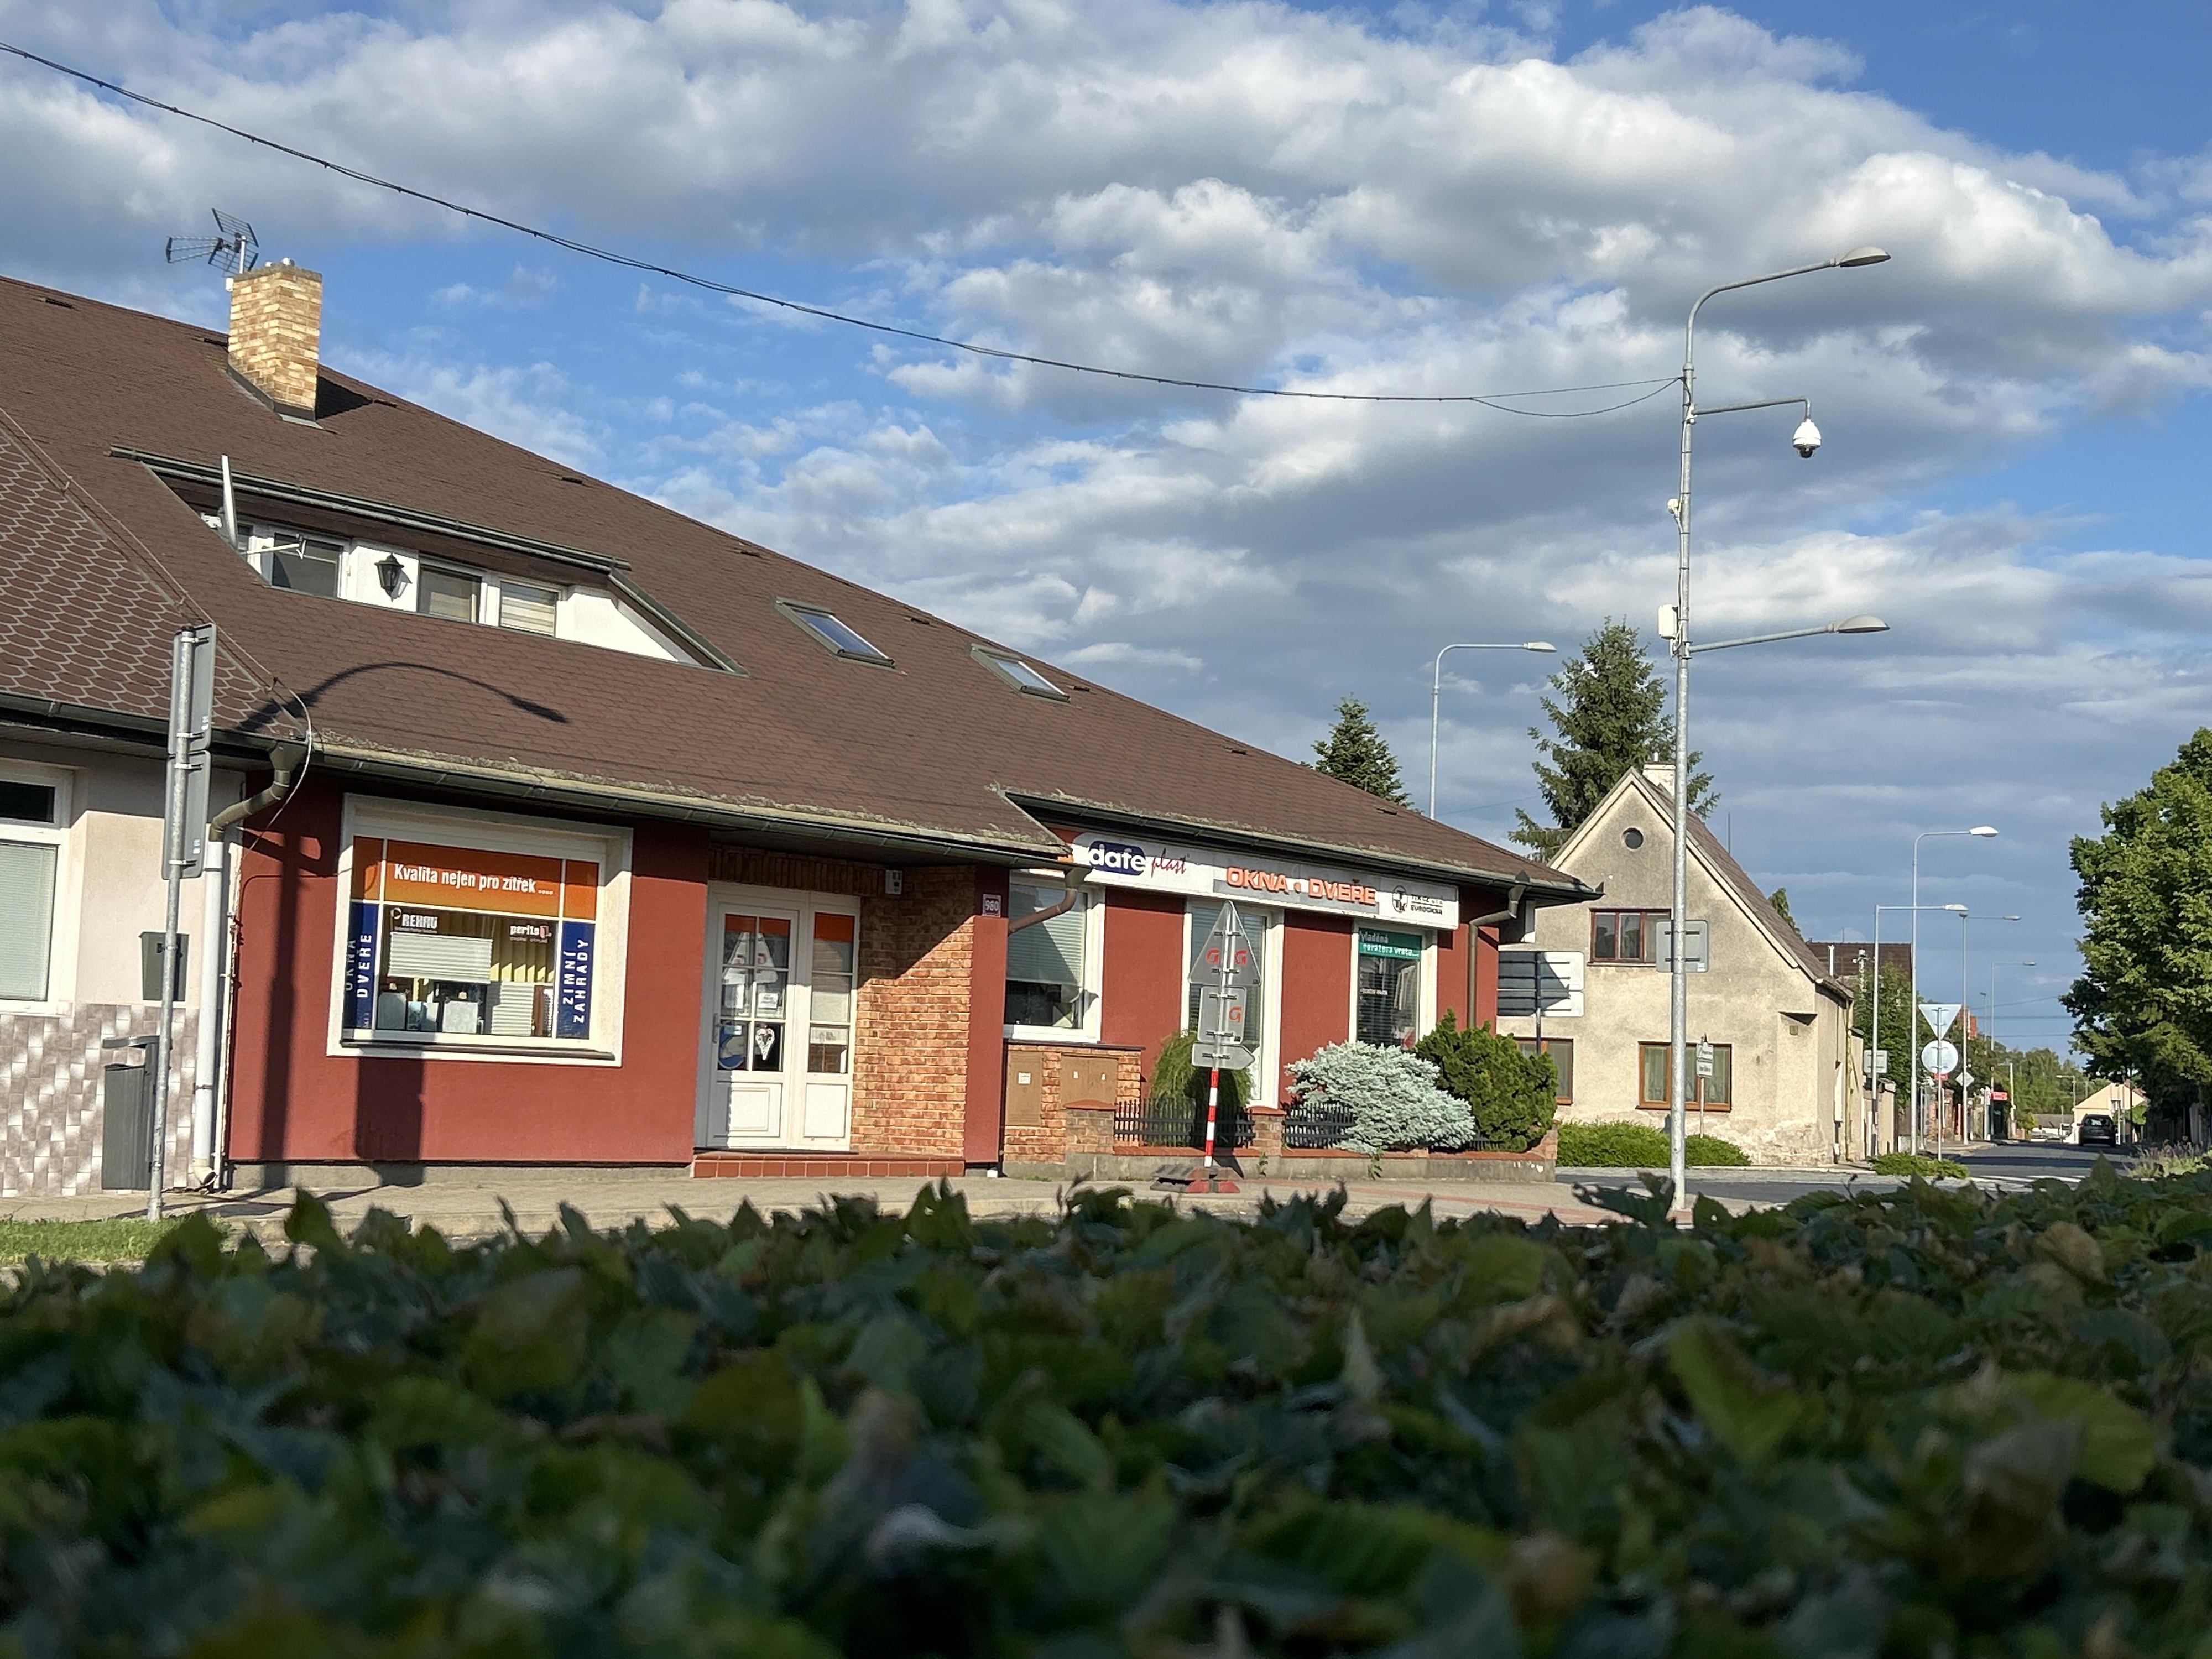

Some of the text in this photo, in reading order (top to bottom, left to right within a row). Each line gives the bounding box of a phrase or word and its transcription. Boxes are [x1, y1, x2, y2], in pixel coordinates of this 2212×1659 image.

[394, 863, 438, 883] Kvalita
[441, 870, 476, 889] nejen
[479, 875, 499, 891] pro
[1227, 867, 1376, 905] OKNA DVEŘE
[401, 914, 438, 929] REHAU
[356, 935, 372, 998] DVEŘE
[563, 951, 576, 1005] ZIMNÍ
[573, 940, 589, 1024] ZAHRADY
